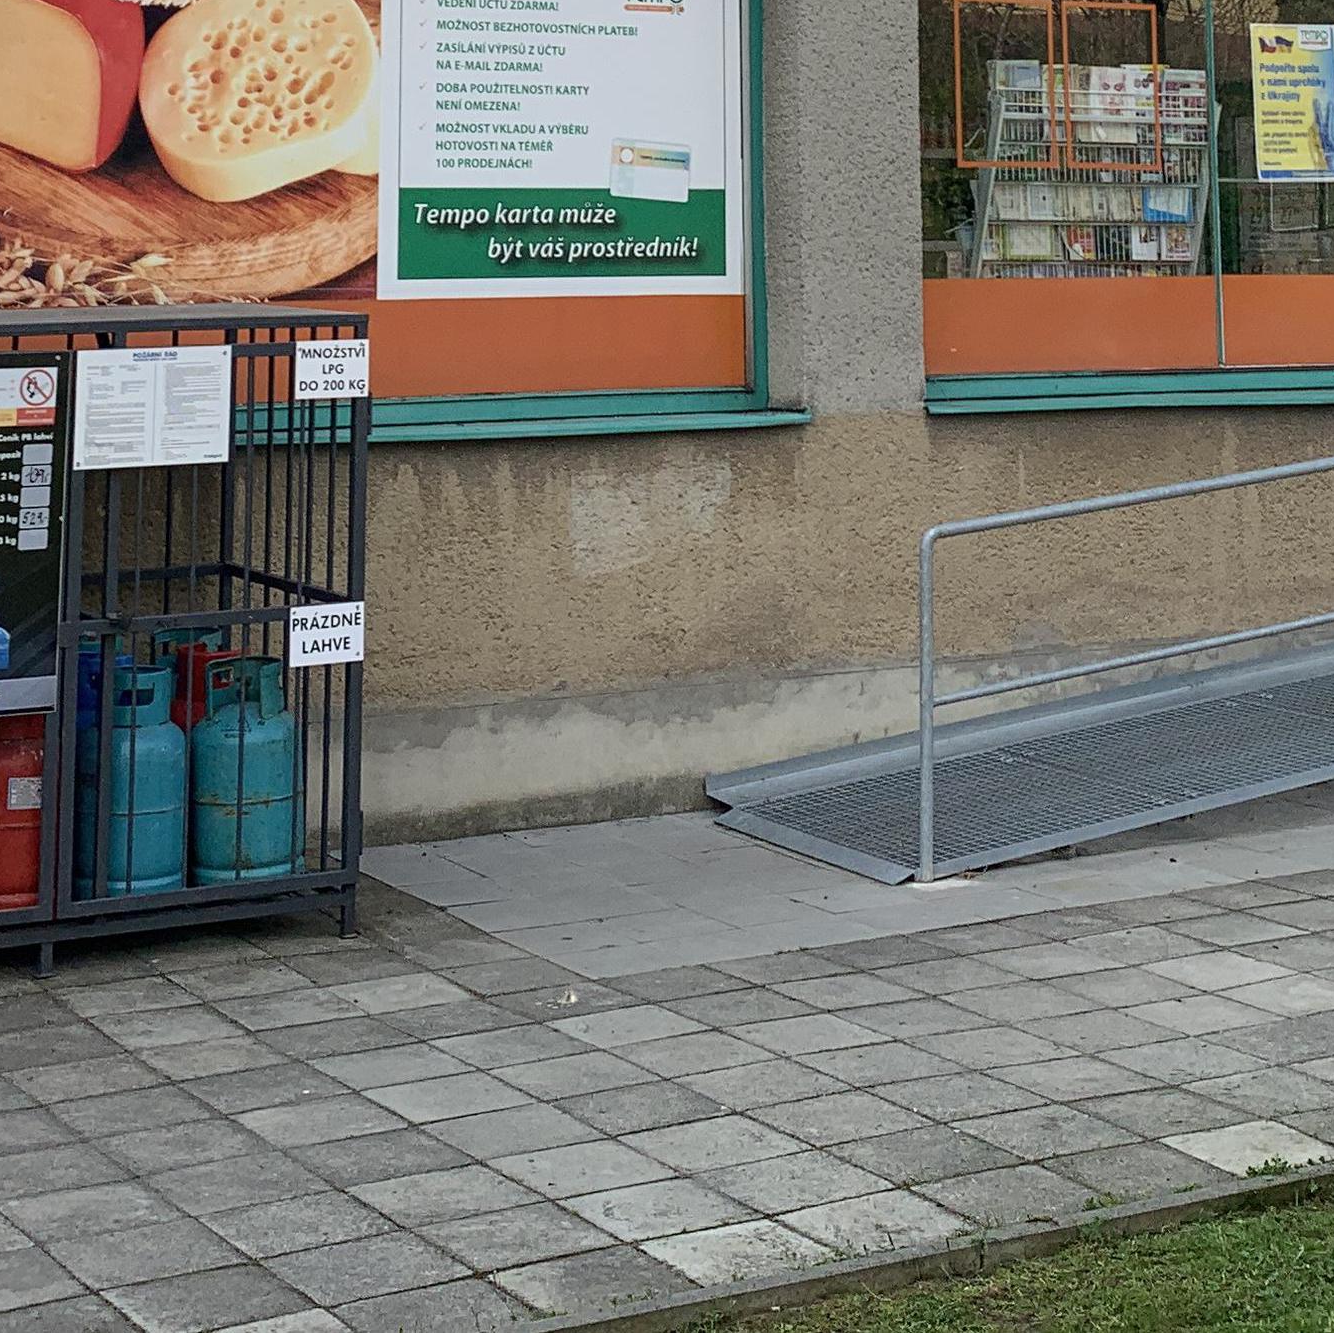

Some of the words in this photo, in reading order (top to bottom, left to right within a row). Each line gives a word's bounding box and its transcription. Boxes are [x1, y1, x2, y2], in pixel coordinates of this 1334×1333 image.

[510, 0, 559, 11] ZDARMA!
[436, 19, 491, 32] MOŽNOST
[493, 21, 596, 35] BEZHOTOVOSTNÍCH
[597, 25, 638, 36] PLATEB!
[528, 45, 535, 55] Z
[436, 60, 452, 70] NA
[455, 61, 491, 71] E-MAIL
[494, 62, 543, 72] ZDARMA!
[436, 82, 468, 93] DOBA
[470, 82, 553, 95] POUŽITELNOSTI
[555, 85, 590, 96] KARTY
[435, 99, 462, 110] NENÍ
[464, 101, 521, 111] OMEZENA!
[435, 121, 491, 133] MOŽNOST
[492, 124, 536, 134] VKLADU
[538, 125, 546, 134] A
[435, 141, 498, 151] HOTOVOSTI
[500, 142, 516, 151] NA
[436, 158, 455, 168] 100
[457, 156, 533, 169] PRODEJNÁCH!
[414, 203, 490, 229] Tempo
[495, 202, 553, 224] karta
[559, 201, 617, 224] může
[488, 236, 523, 264] být
[529, 236, 564, 258] váš
[568, 236, 699, 263] prostředník!
[300, 342, 366, 359] MNOŽSTVÍ
[322, 363, 345, 375] LPG
[299, 380, 319, 392] DO
[322, 379, 345, 391] 200
[348, 378, 366, 391] KG
[291, 609, 362, 633] PRÁZDNÉ
[301, 637, 352, 655] LAHVE
